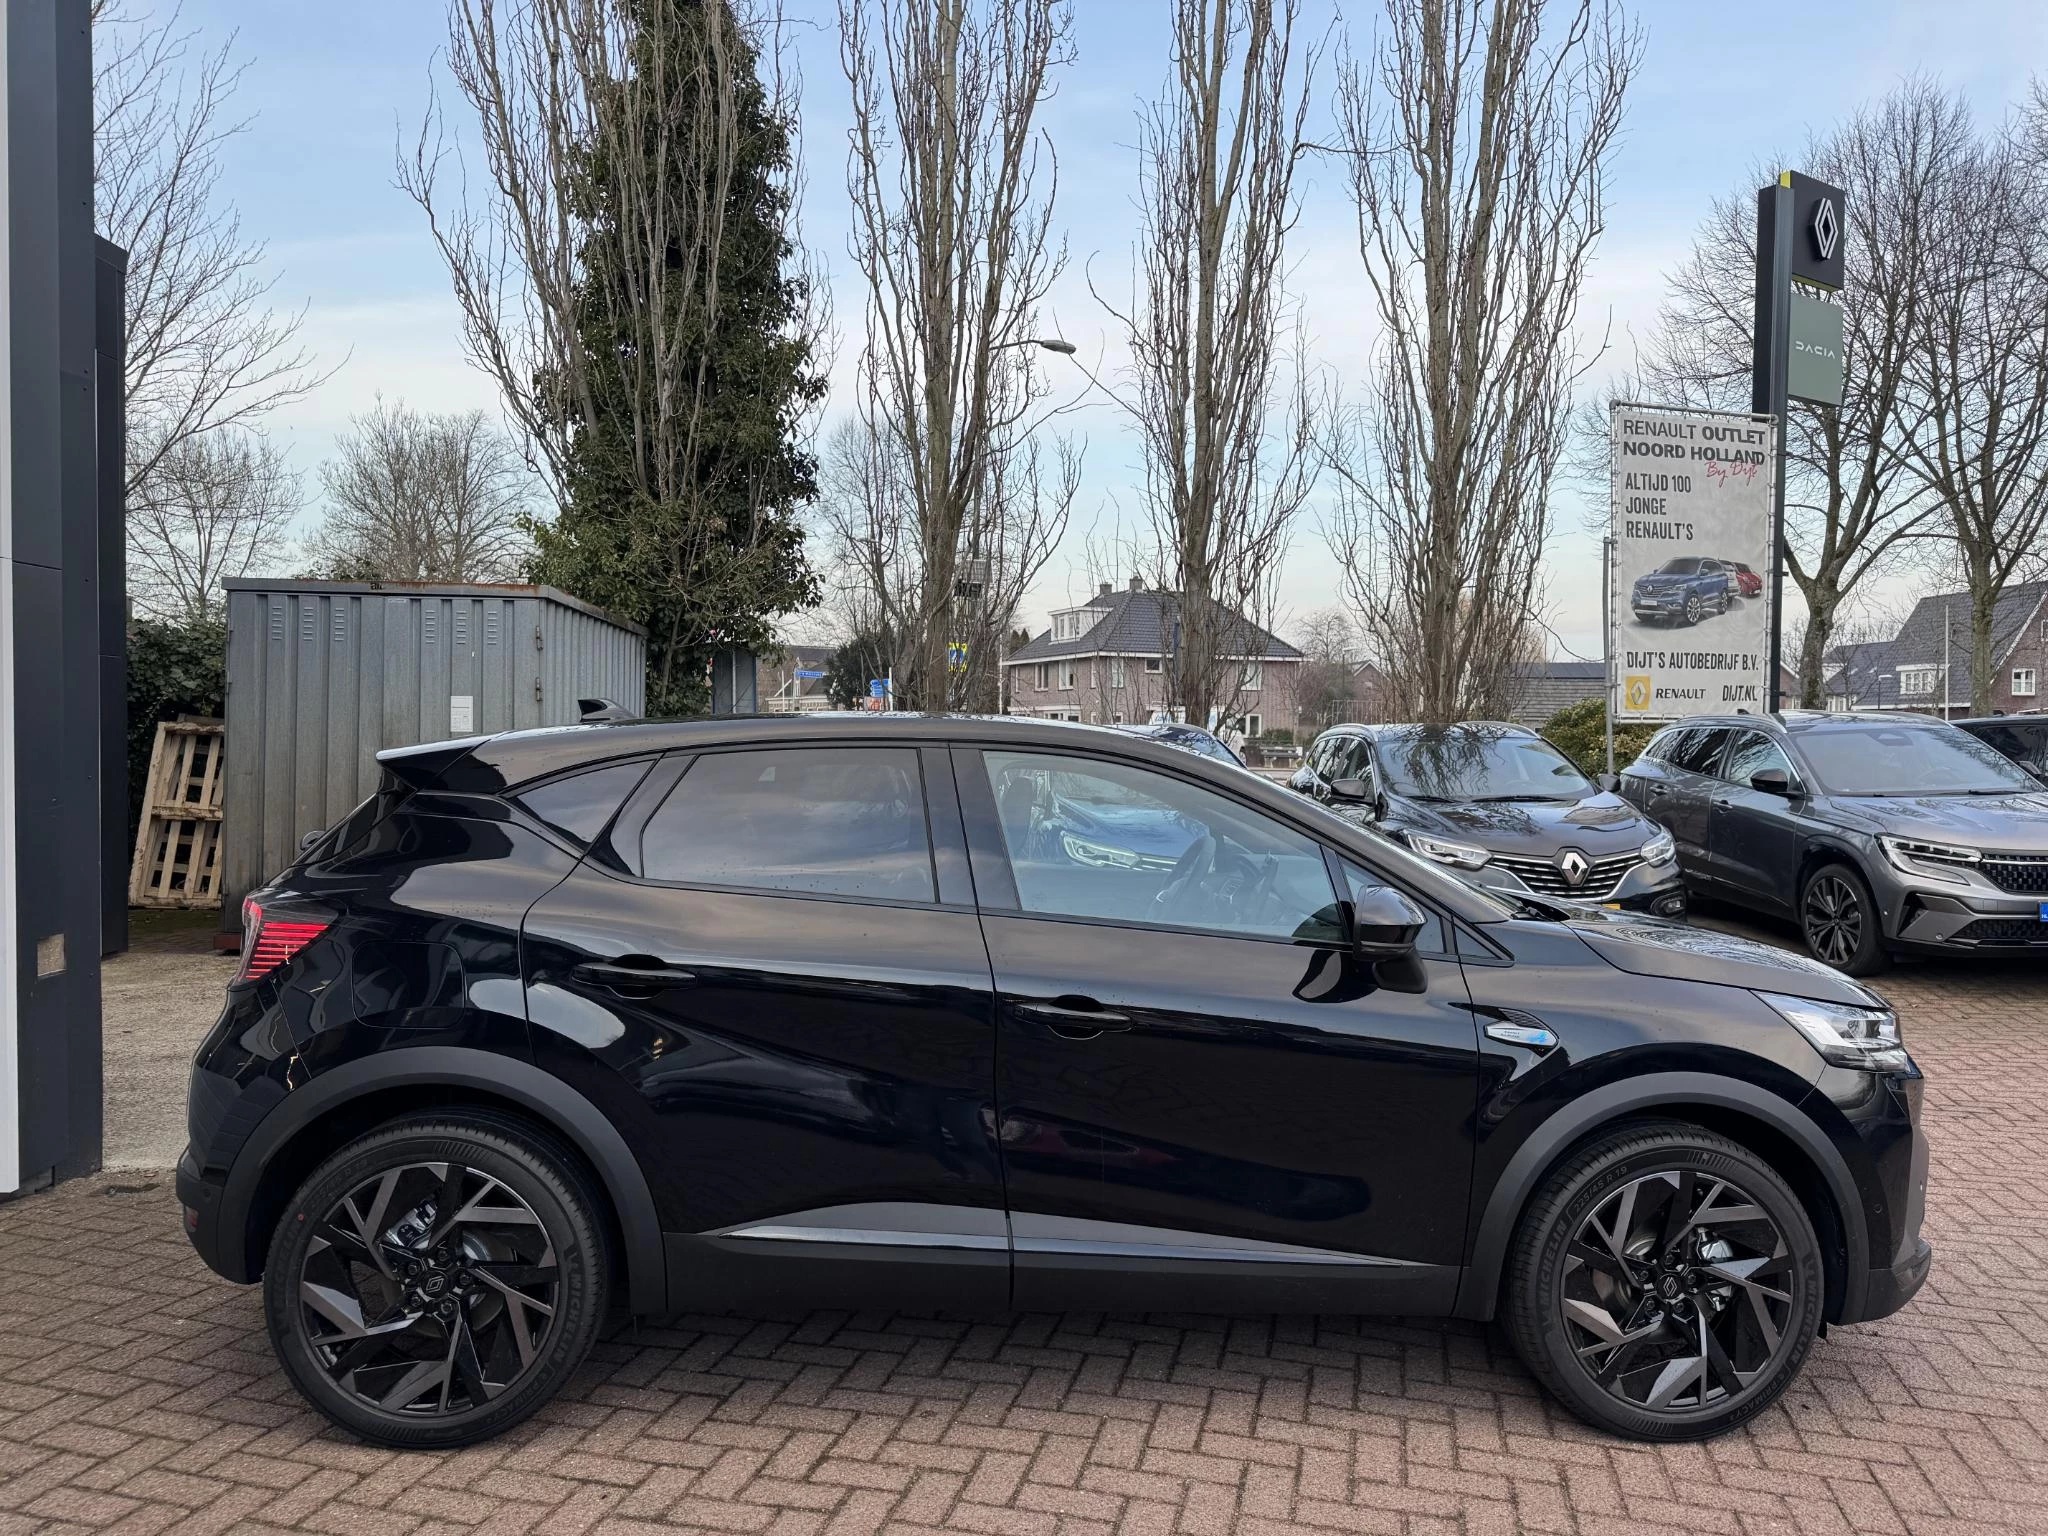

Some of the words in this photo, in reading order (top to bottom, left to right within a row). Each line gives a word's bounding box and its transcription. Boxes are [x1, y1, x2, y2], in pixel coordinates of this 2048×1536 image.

[1795, 340, 1836, 359] DACIA
[1624, 420, 1696, 439] RENAULT
[1702, 426, 1765, 445] OUTLET
[1623, 441, 1685, 459] NOORD
[1691, 446, 1765, 465] HOLLAND
[1625, 473, 1668, 491] ALTIJD
[1672, 475, 1691, 493] 100
[1705, 461, 1728, 487] By
[1626, 497, 1666, 515] JONGE
[1626, 521, 1693, 540] RENAULT'S
[1627, 651, 1665, 668] DIJT'S
[1669, 653, 1739, 670] AUTOBEDRIJF
[1742, 654, 1759, 671] B.V.
[1656, 688, 1706, 699] RENAULT
[1723, 685, 1757, 701] DIJT.NL
[1574, 1179, 1605, 1210] 225/45
[1605, 1173, 1614, 1183] R
[1615, 1165, 1628, 1177] 19
[1539, 1218, 1568, 1305] MICHELIN
[553, 1272, 581, 1361] MICHELIN
[1788, 1279, 1817, 1363] MICHELIN
[1732, 1377, 1780, 1419] PRIMACY
